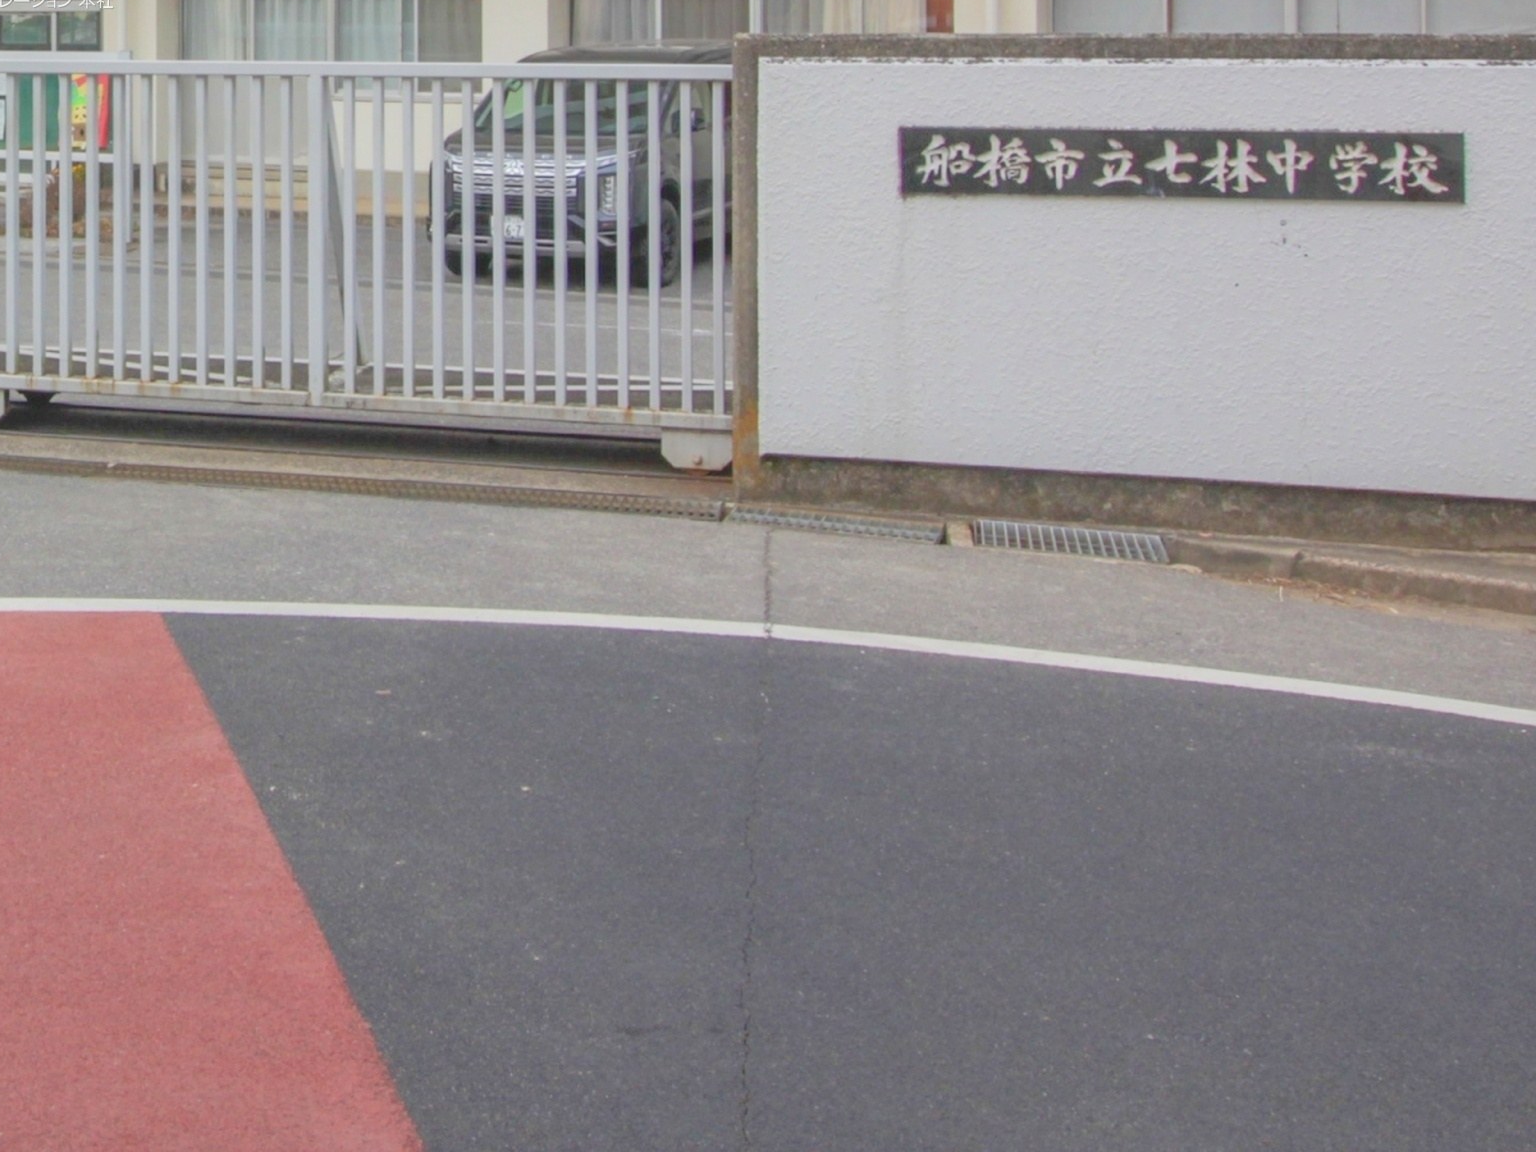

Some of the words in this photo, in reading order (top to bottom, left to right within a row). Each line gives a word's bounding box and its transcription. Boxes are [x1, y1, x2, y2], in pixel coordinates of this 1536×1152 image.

[915, 133, 1449, 195] 船橋市立七林中学校
